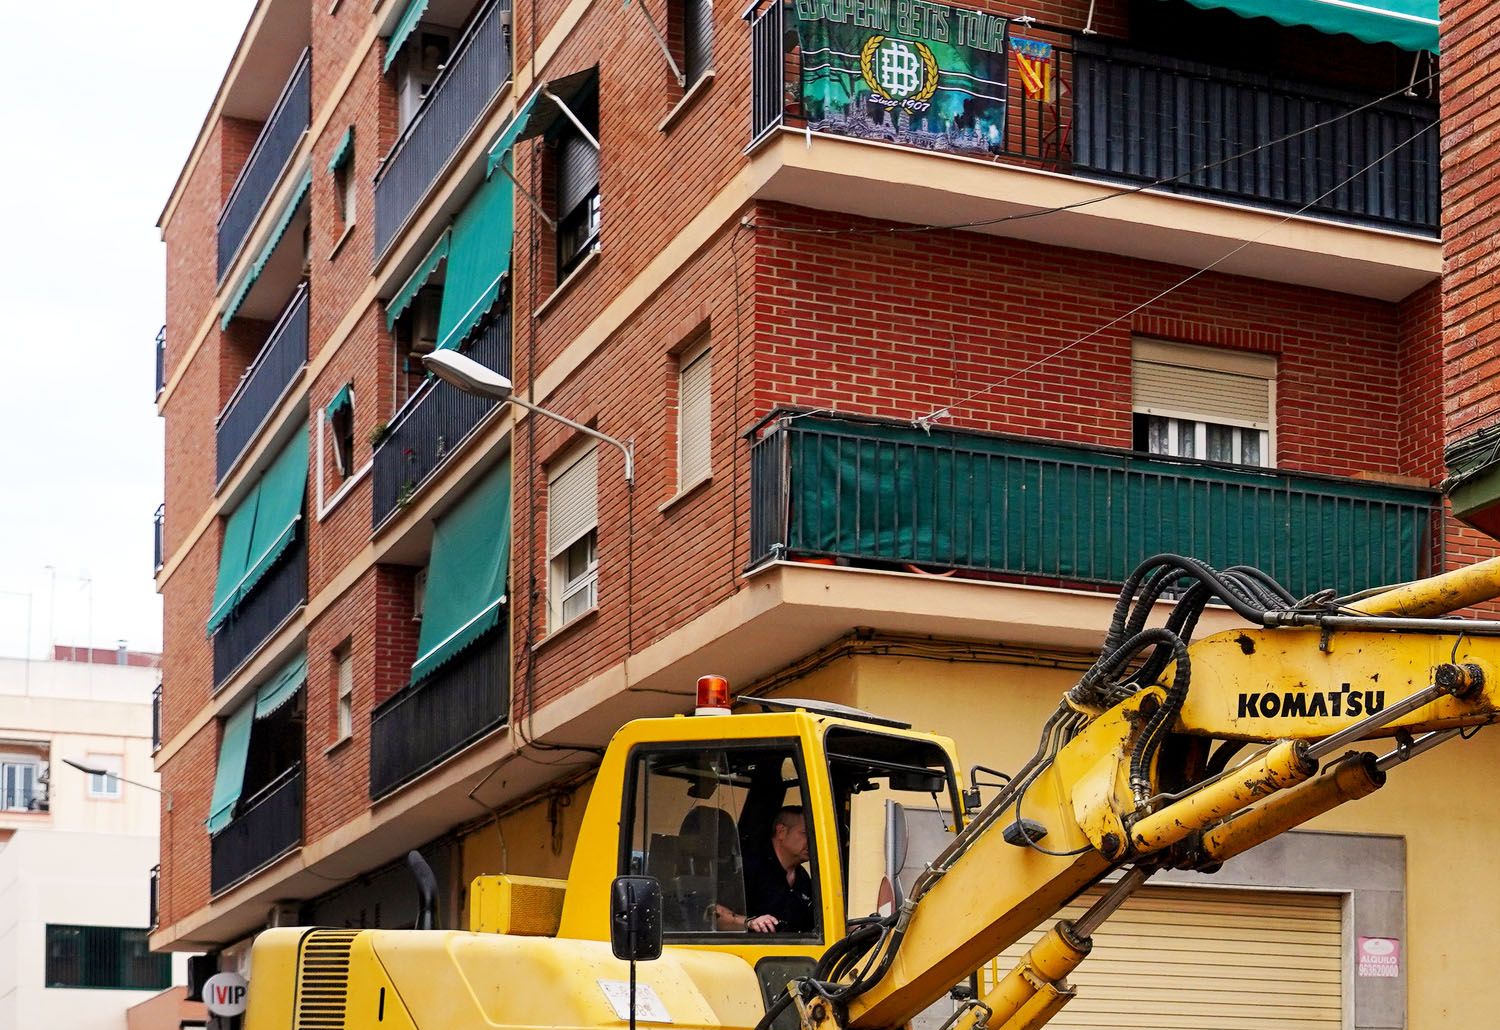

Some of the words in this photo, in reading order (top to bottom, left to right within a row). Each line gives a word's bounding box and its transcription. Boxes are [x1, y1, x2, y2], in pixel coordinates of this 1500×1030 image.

[956, 8, 1007, 54] TOUR
[869, 93, 898, 107] Since
[901, 99, 931, 112] 1907
[1237, 683, 1385, 718] KOMATSU
[1360, 955, 1397, 964] ALQUILO
